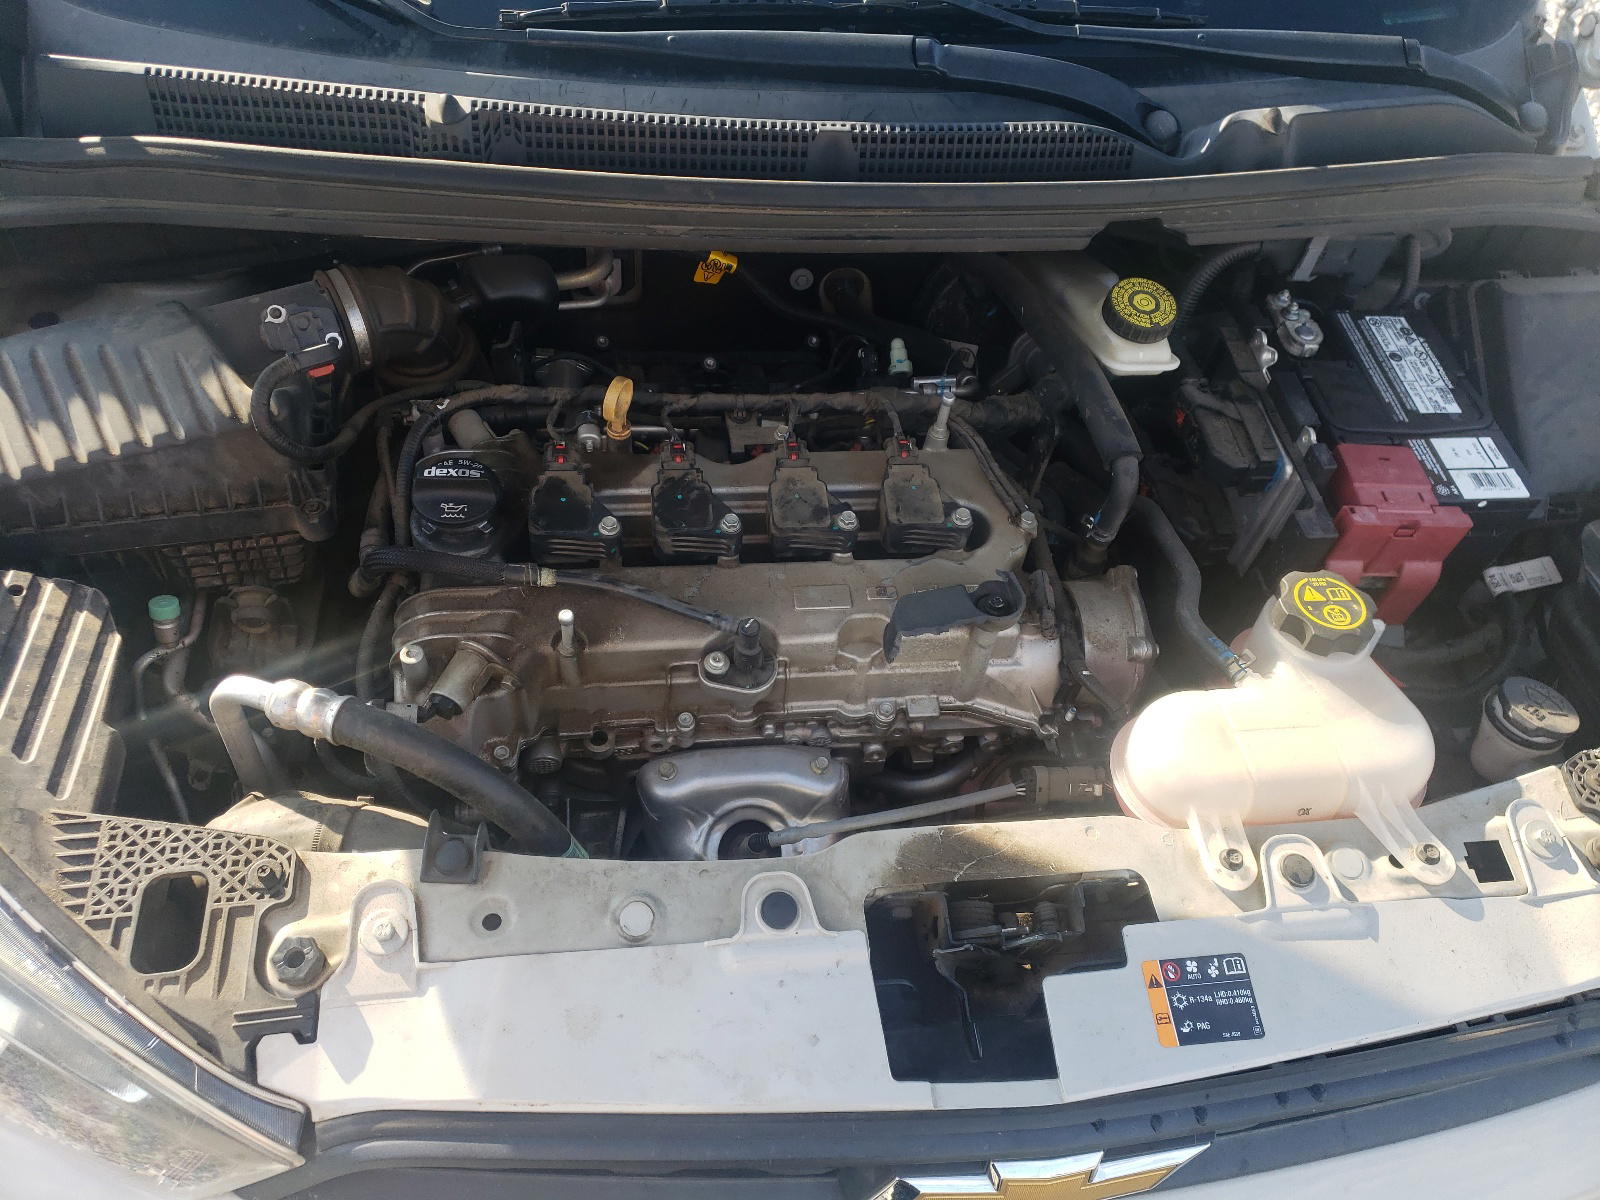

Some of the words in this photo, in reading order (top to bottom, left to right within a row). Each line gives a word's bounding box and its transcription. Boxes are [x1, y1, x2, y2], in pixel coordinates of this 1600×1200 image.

[423, 466, 481, 478] dexos
[1189, 995, 1213, 1004] R-134a
[1196, 1021, 1211, 1030] PAG
